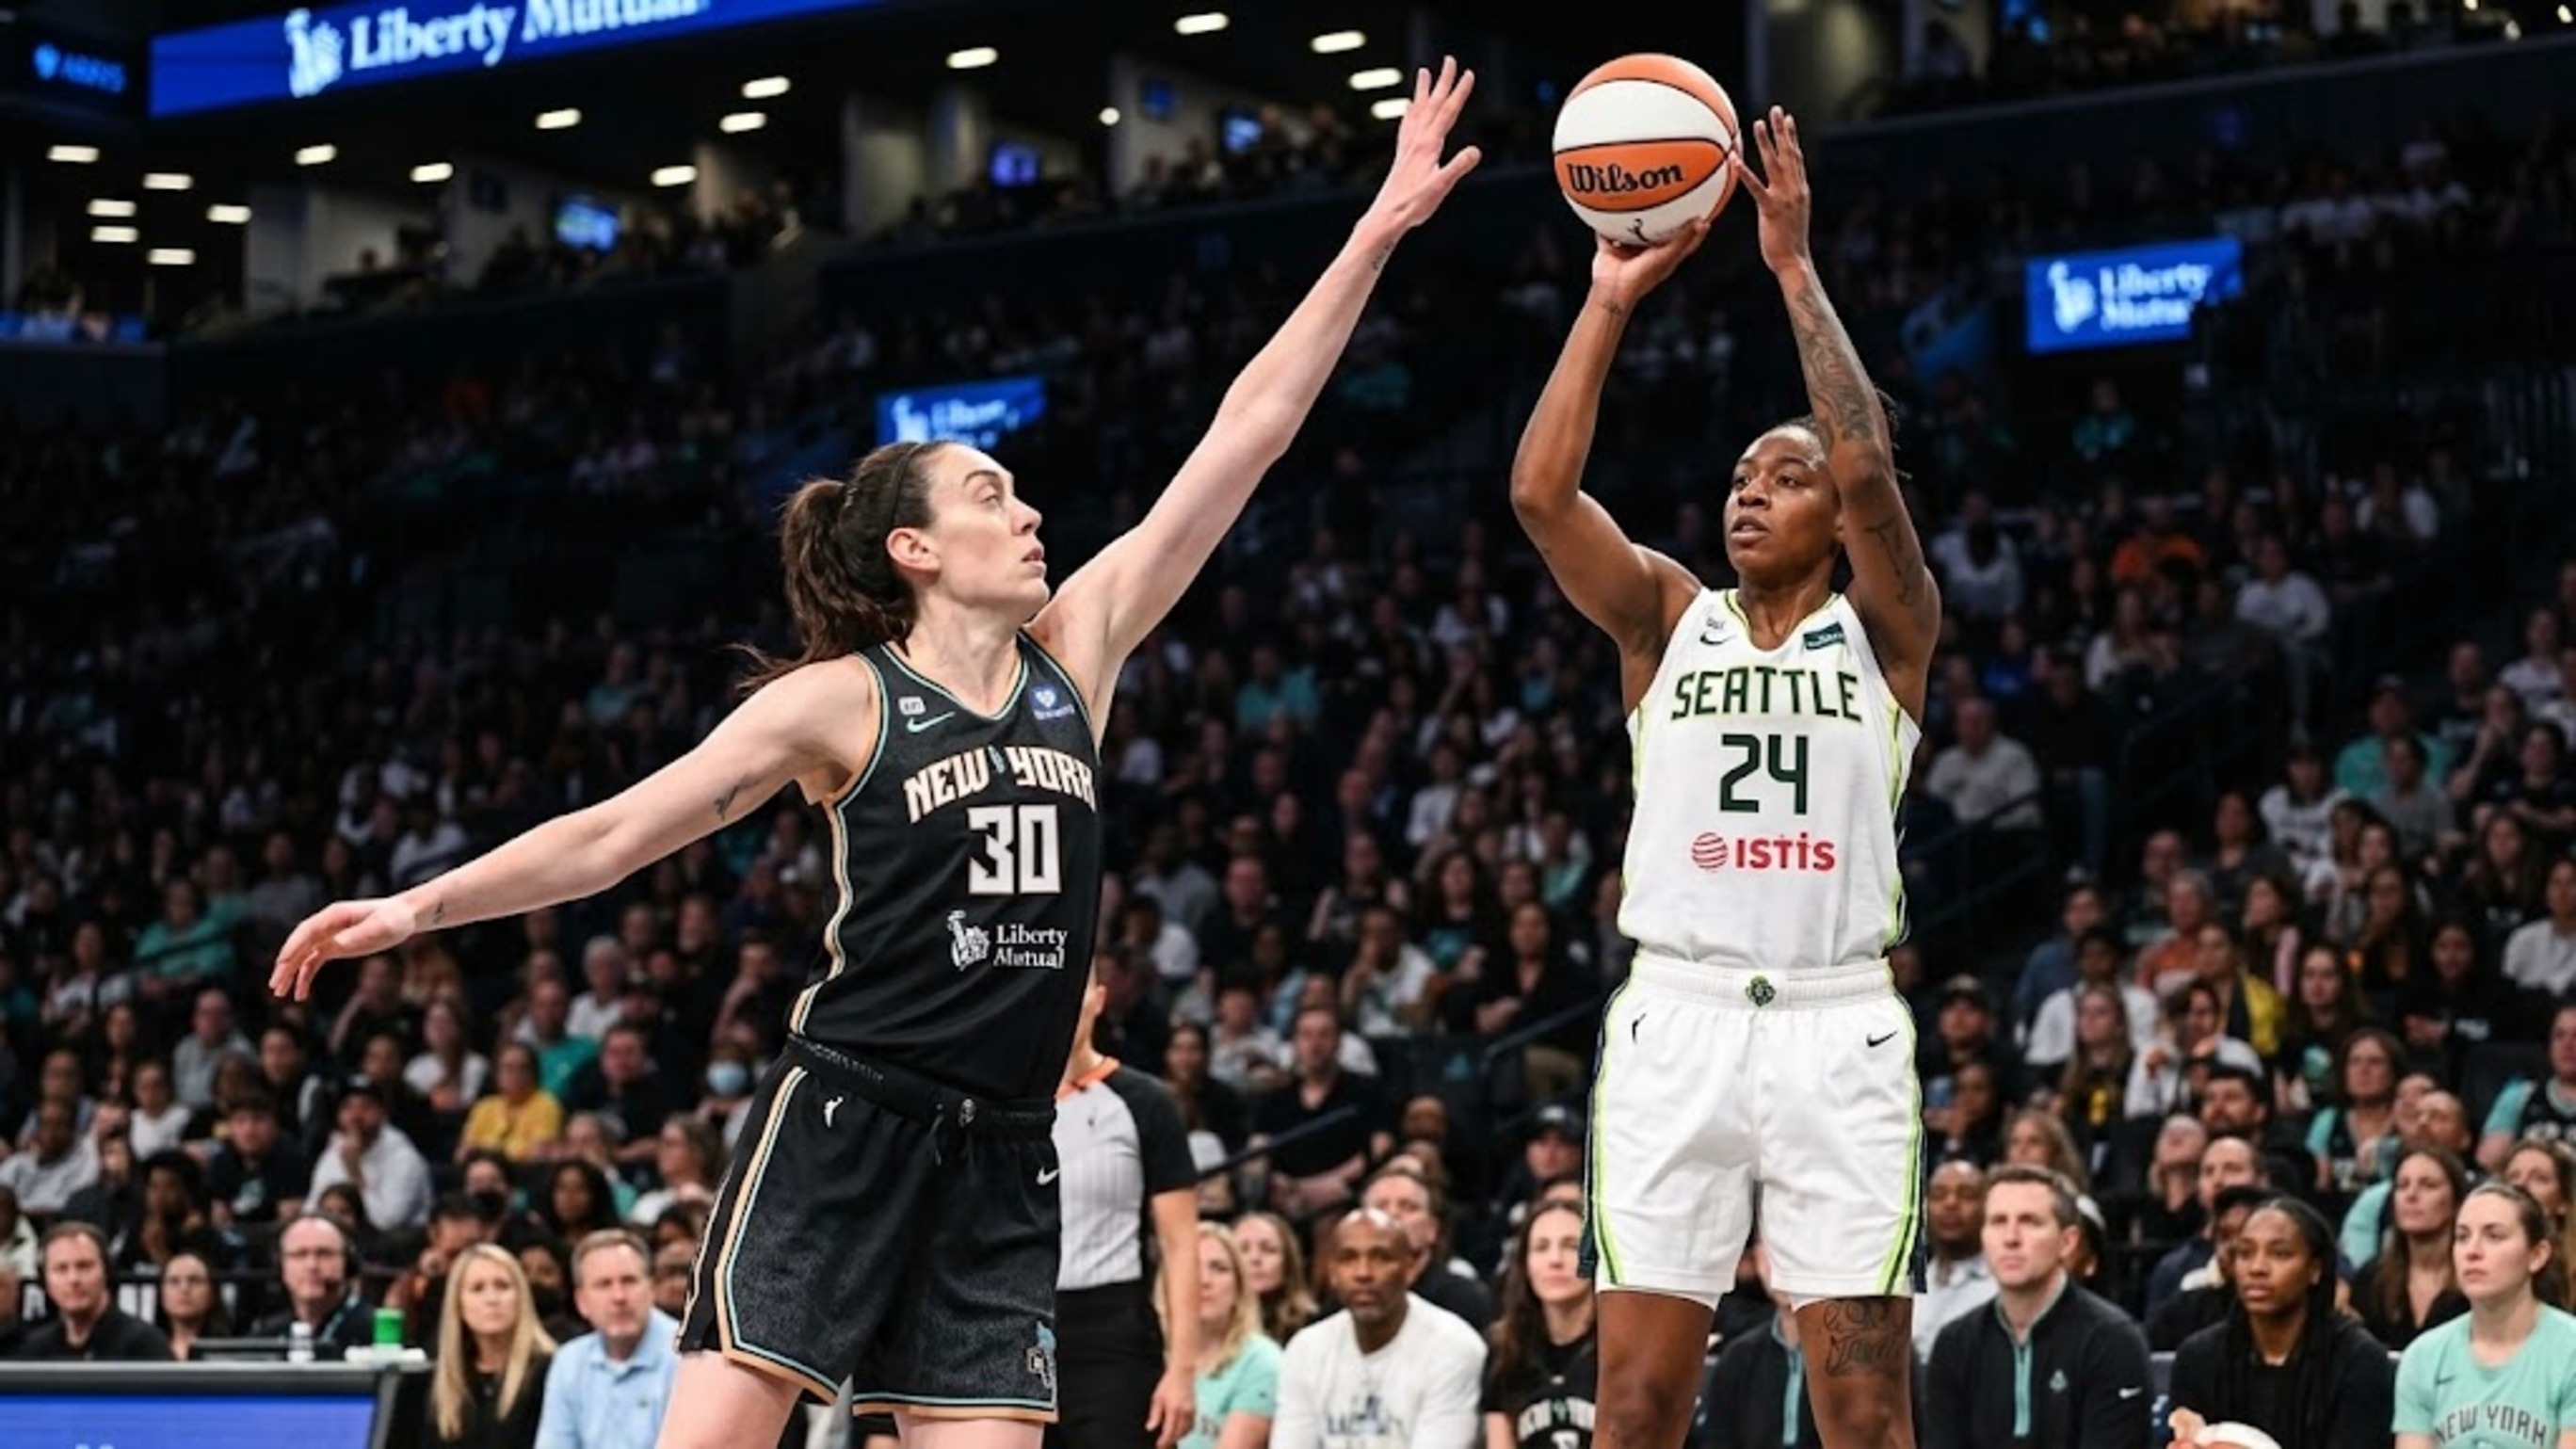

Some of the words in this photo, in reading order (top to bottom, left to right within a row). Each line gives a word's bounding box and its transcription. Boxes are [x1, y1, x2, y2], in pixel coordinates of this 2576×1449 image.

[350, 4, 517, 70] Liberty
[522, 0, 700, 43] Mutua
[1566, 162, 1684, 194] Wilson
[1671, 665, 1862, 724] SEATTLE
[903, 747, 990, 824] NEW
[1005, 746, 1097, 813] YORK
[1719, 733, 1809, 816] 24
[967, 804, 1062, 895] 30
[993, 946, 1065, 969] Mutual
[996, 924, 1068, 950] Liberty
[2435, 1407, 2478, 1443] NEW
[2487, 1405, 2547, 1447] YORK
